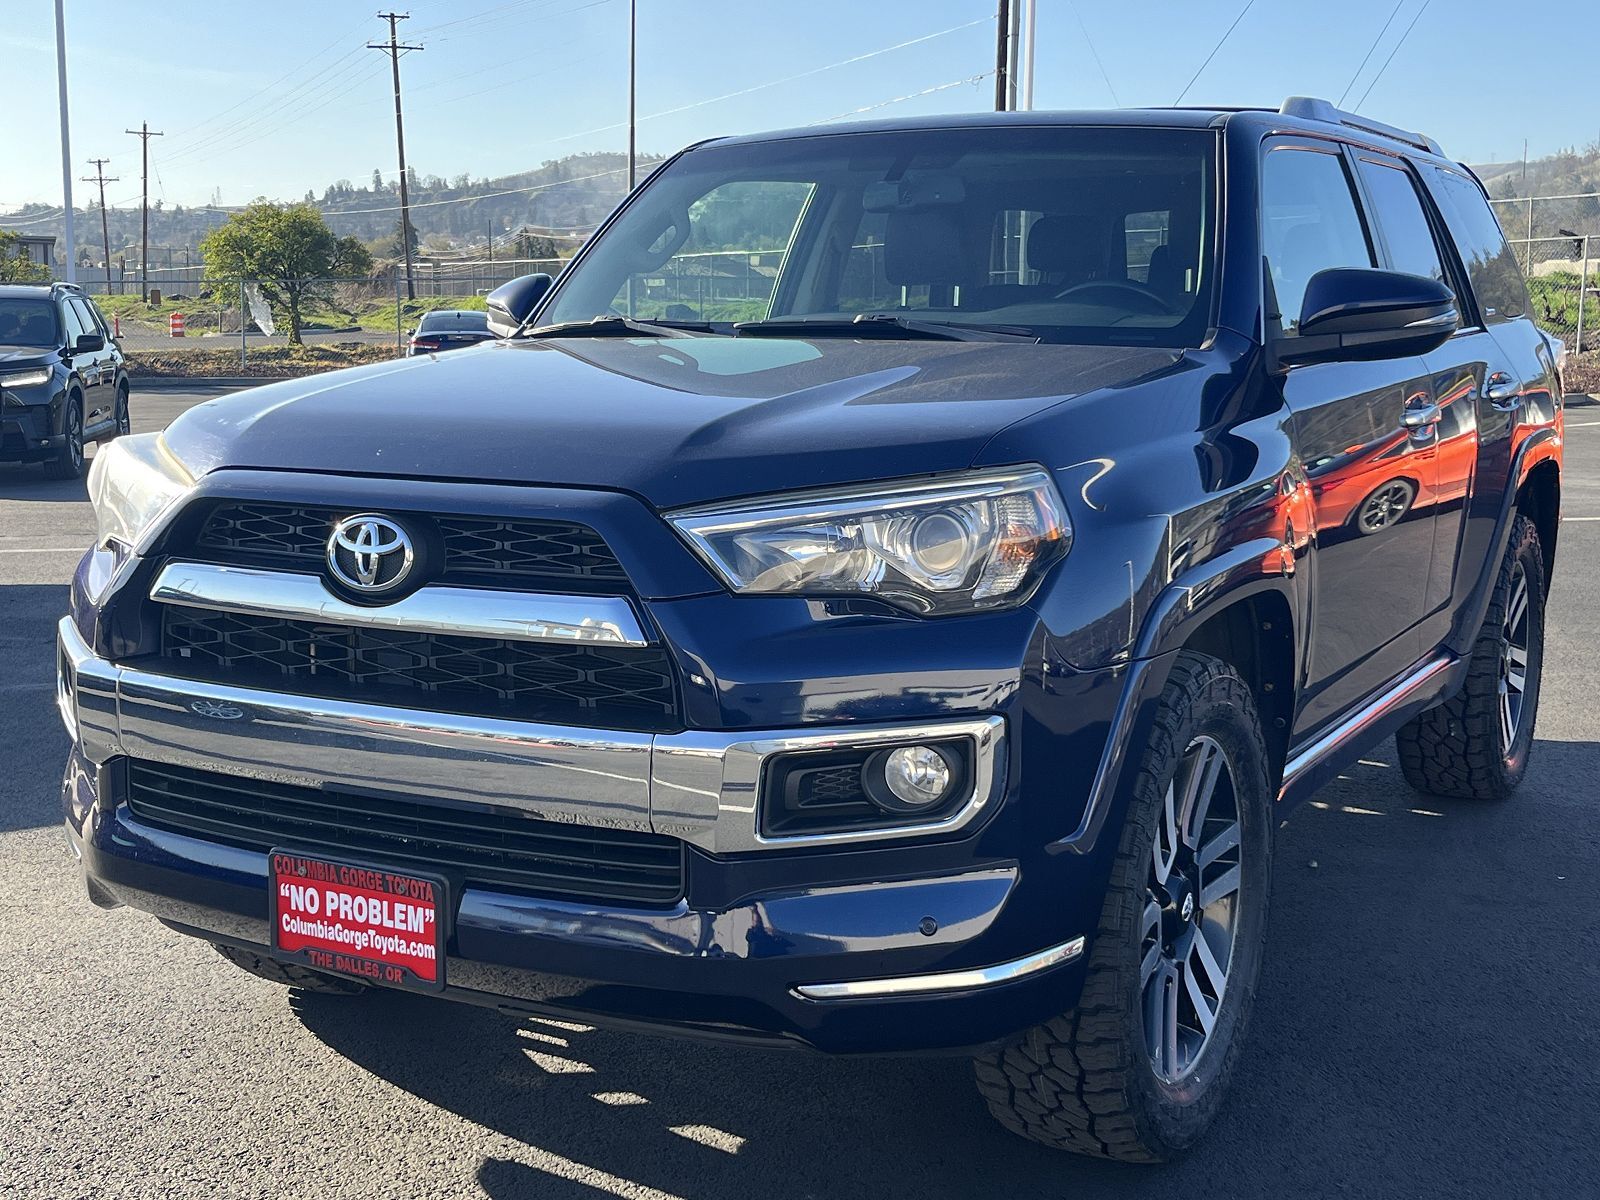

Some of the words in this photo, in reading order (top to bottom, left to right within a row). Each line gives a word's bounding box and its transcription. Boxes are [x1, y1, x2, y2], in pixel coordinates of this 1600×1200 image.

[340, 866, 384, 893] GORGE
[386, 875, 434, 901] TOYOTA
[282, 913, 436, 960] ColumbiaGorgeToyota.com
[309, 950, 334, 968] THE
[336, 955, 383, 981] DALLES,
[385, 966, 403, 983] OR
